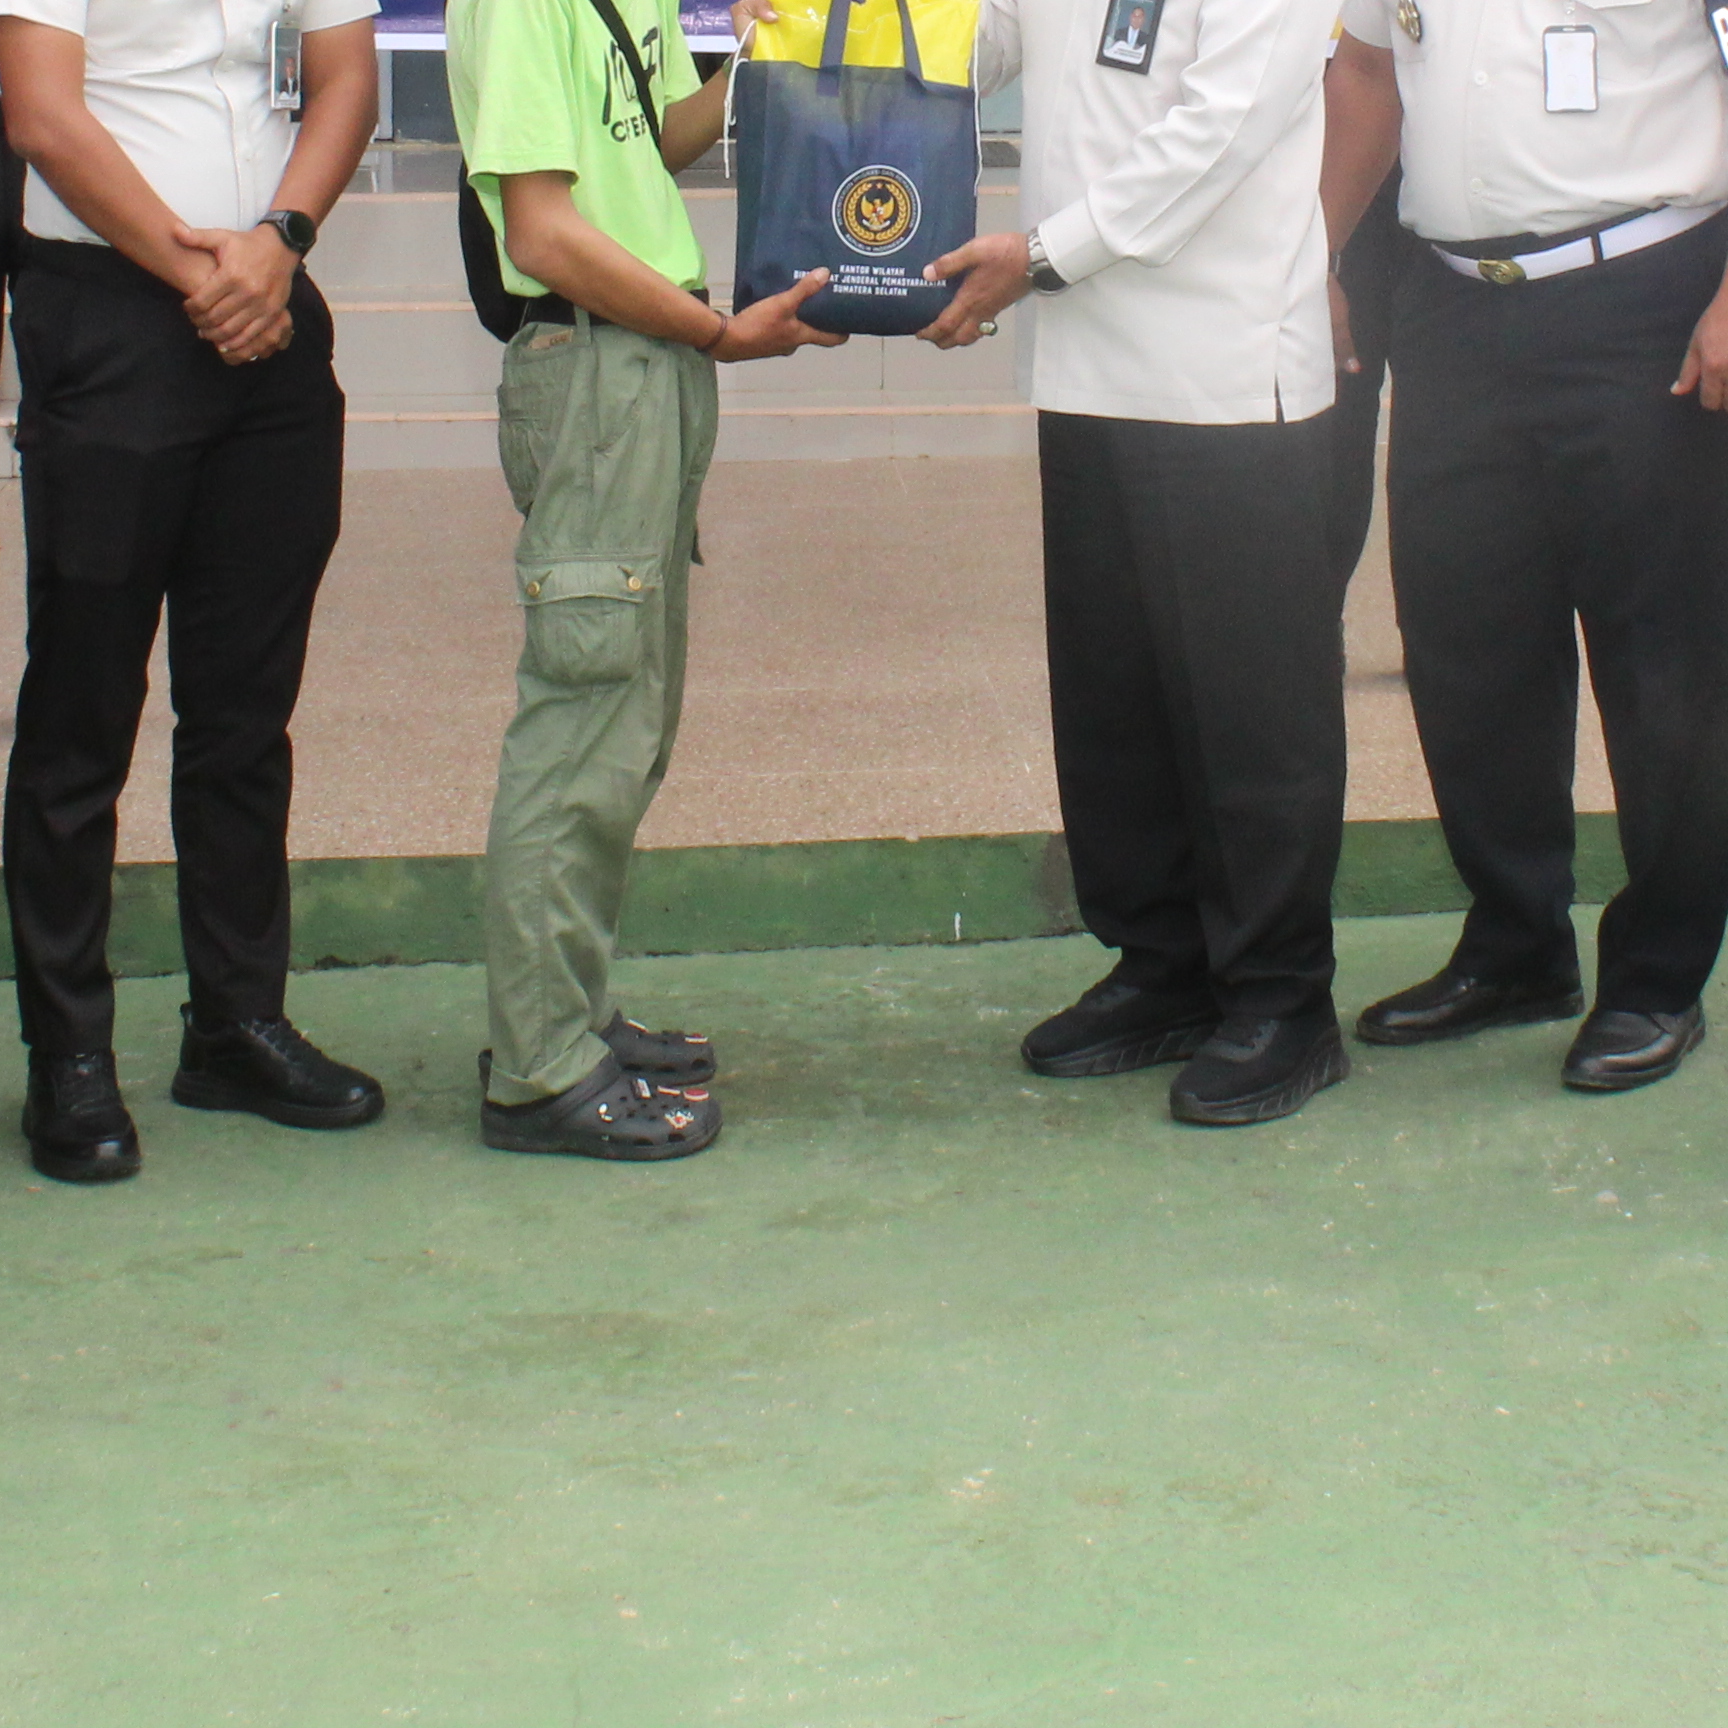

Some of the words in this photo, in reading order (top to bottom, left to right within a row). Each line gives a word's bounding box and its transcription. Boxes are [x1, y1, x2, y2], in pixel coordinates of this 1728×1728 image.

[839, 264, 870, 275] KANTOR
[872, 266, 905, 276] WILAYAH
[833, 284, 872, 295] SUMATERA
[874, 286, 908, 297] SELATAN
